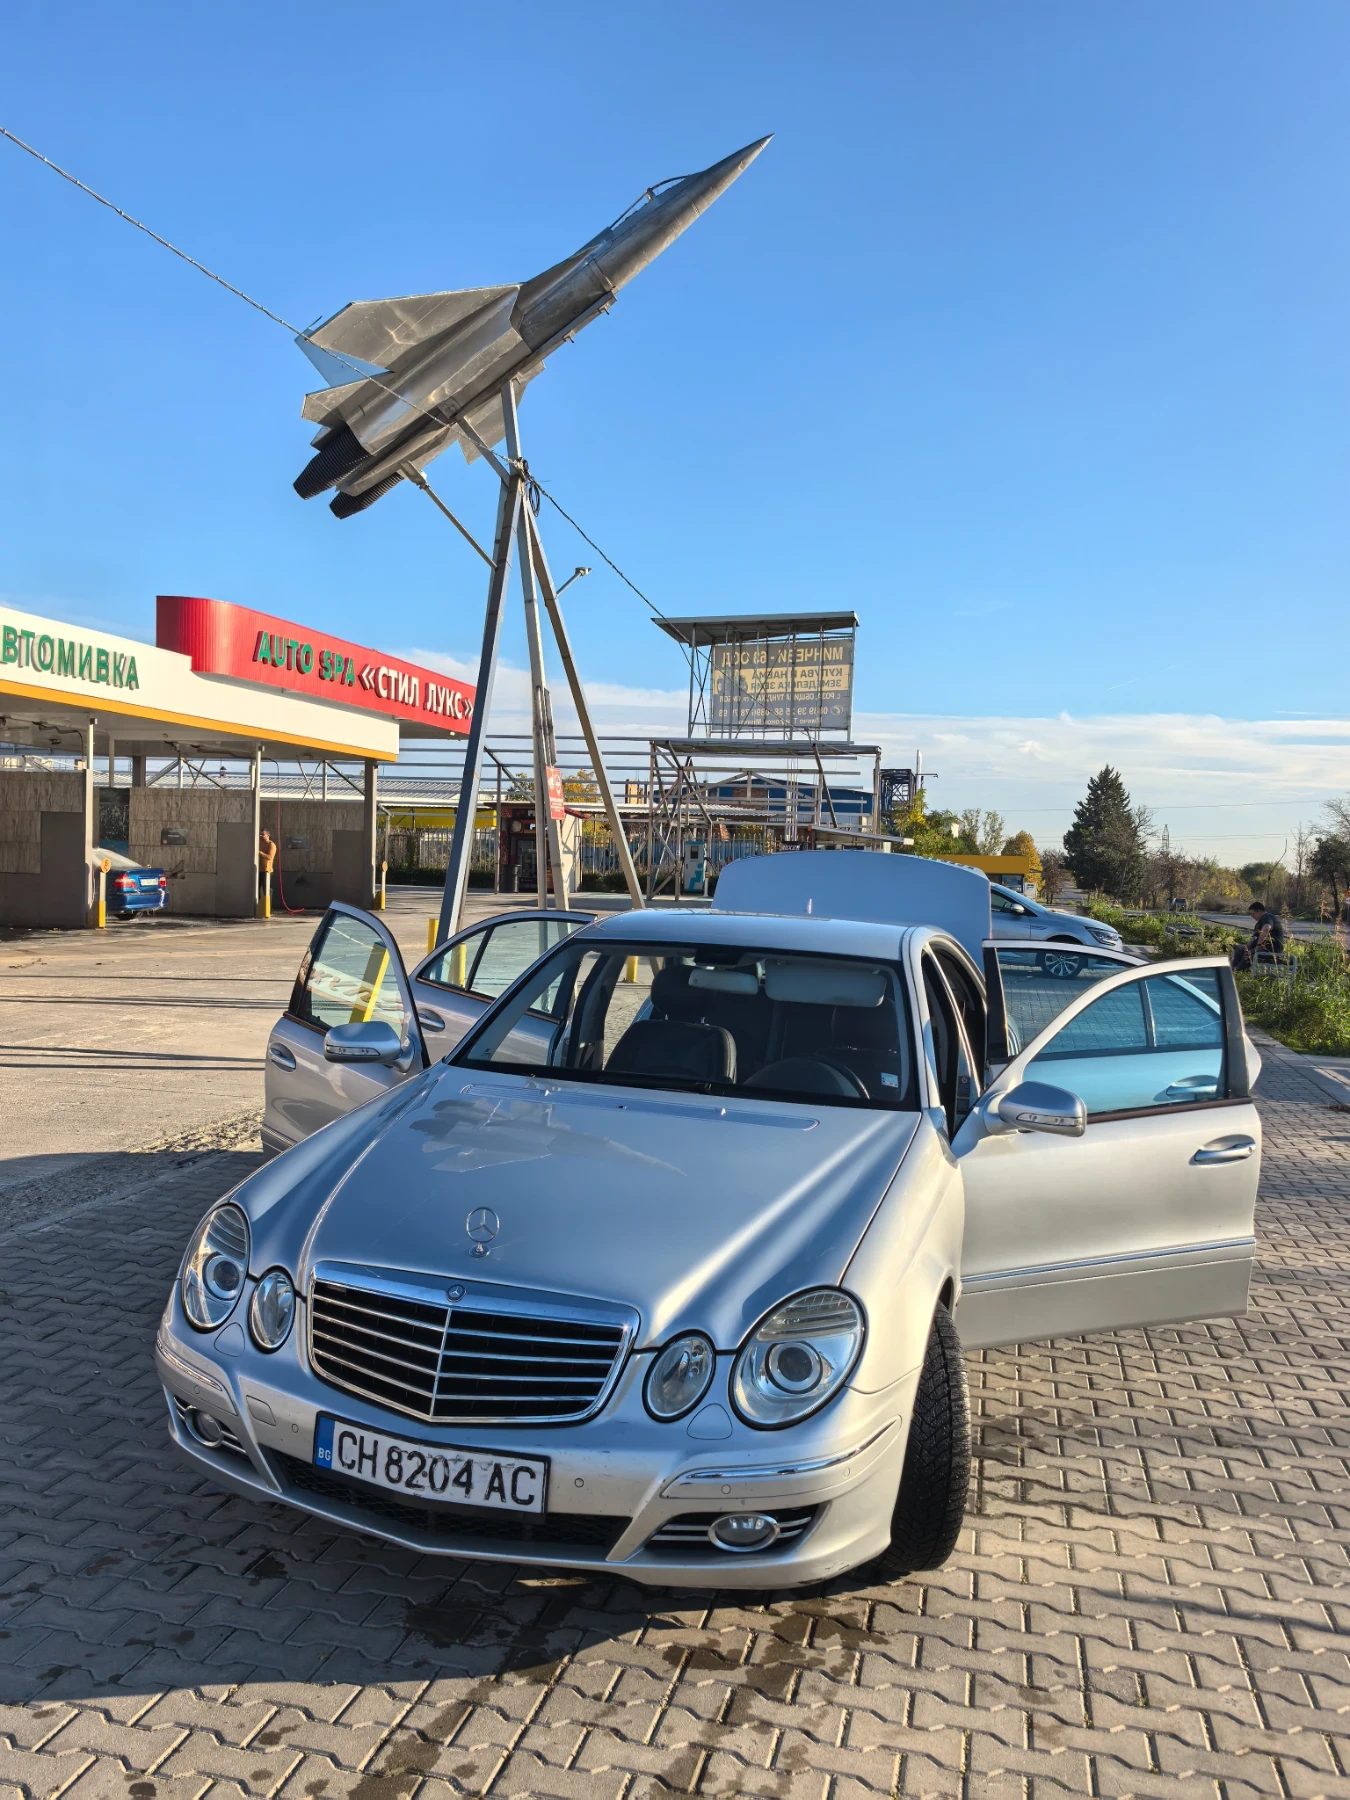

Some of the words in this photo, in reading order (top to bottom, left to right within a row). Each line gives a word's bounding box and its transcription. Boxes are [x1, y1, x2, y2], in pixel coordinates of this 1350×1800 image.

[253, 631, 314, 674] AUTO
[318, 650, 356, 687] SPA
[358, 664, 419, 706] «СТИЛ
[424, 682, 474, 719] ЛУКС»
[318, 1447, 331, 1461] BG
[384, 1445, 474, 1498] 8204
[484, 1462, 537, 1506] AC
